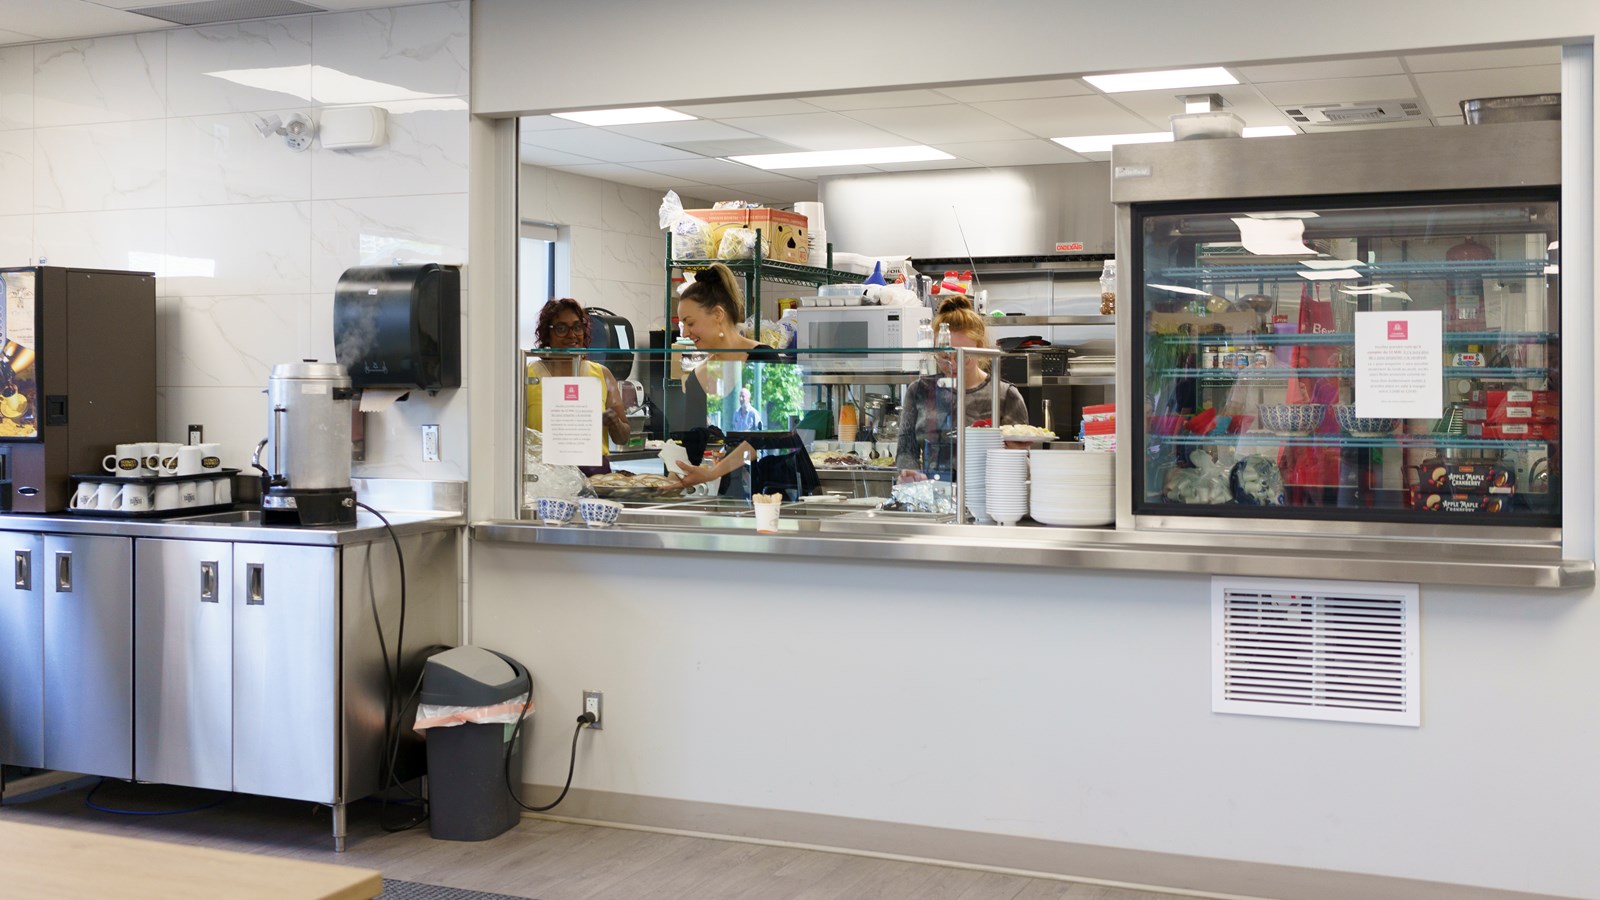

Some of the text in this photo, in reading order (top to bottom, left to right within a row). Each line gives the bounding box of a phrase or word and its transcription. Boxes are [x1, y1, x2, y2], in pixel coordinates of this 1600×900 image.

[1448, 473, 1485, 482] APPLE MAPLE
[1451, 479, 1481, 487] CRANBERRY
[1442, 500, 1479, 509] APPLE MAPLE
